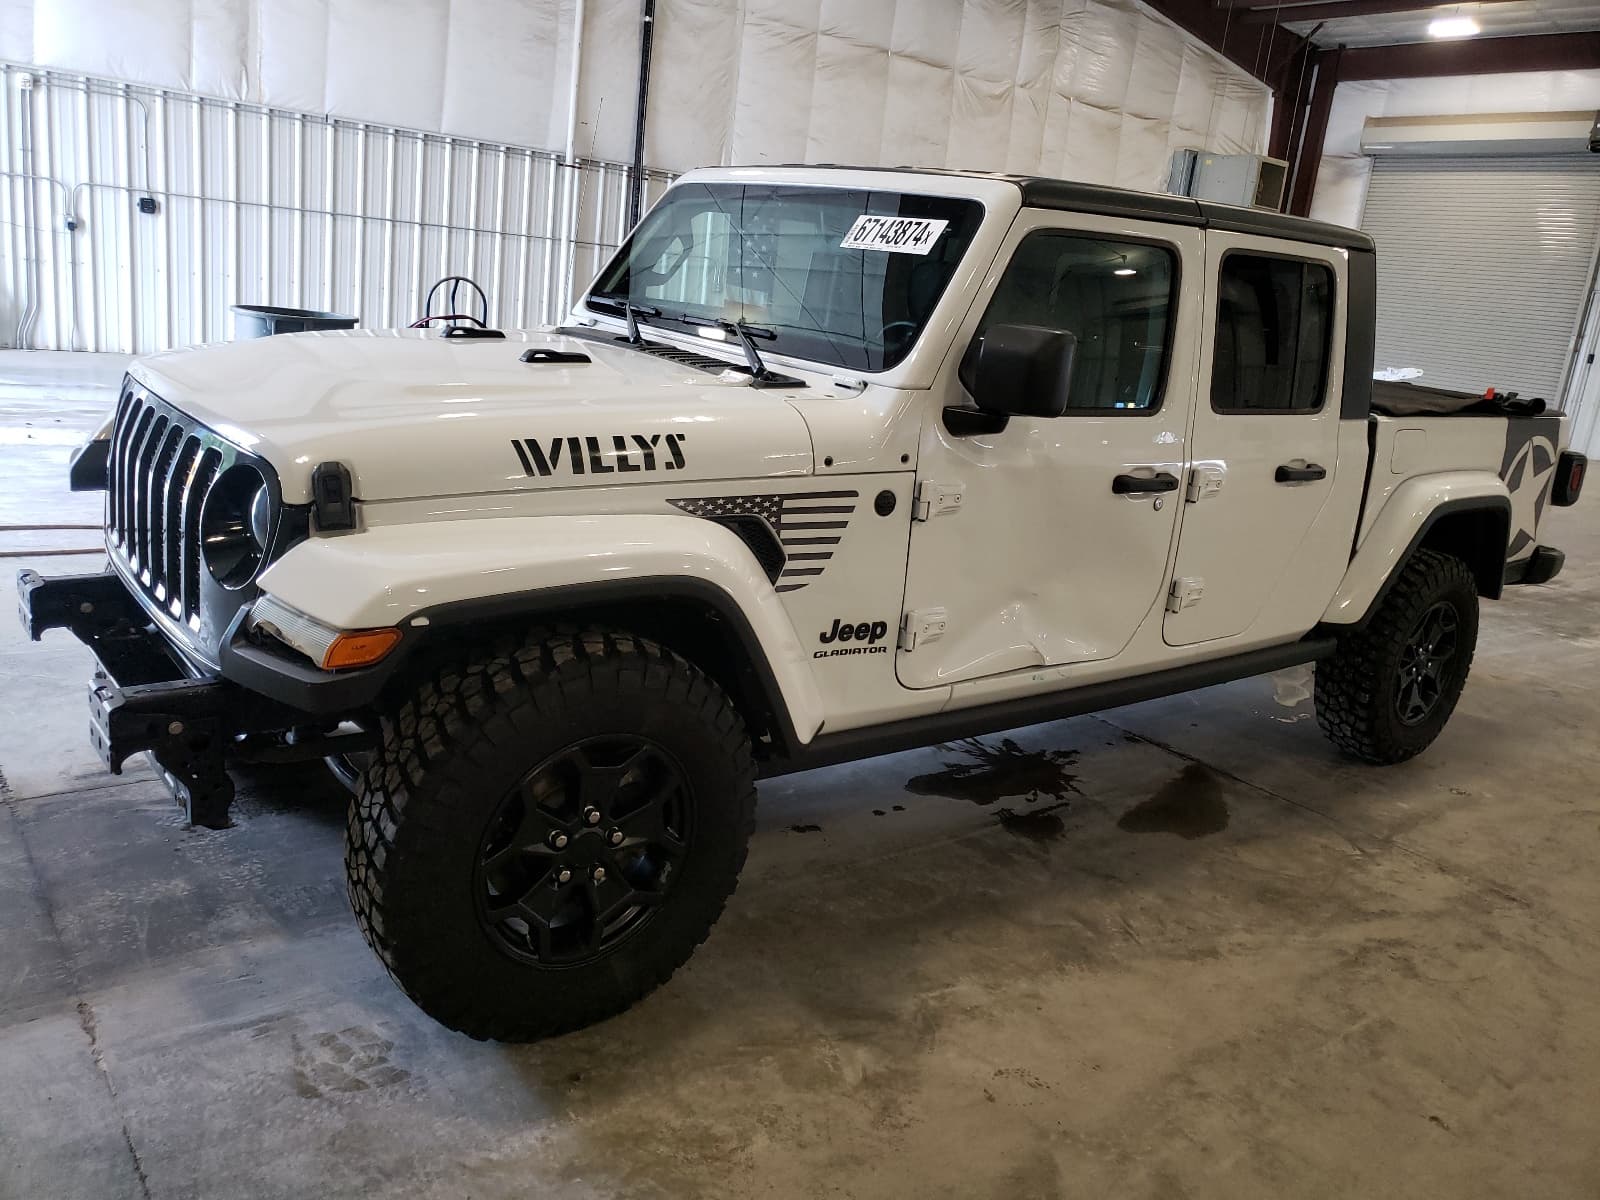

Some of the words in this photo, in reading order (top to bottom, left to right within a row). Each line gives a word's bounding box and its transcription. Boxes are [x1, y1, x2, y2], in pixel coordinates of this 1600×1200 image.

[510, 433, 686, 477] WILLYS
[819, 618, 887, 645] Jeep
[813, 646, 887, 659] GLADIATOR
